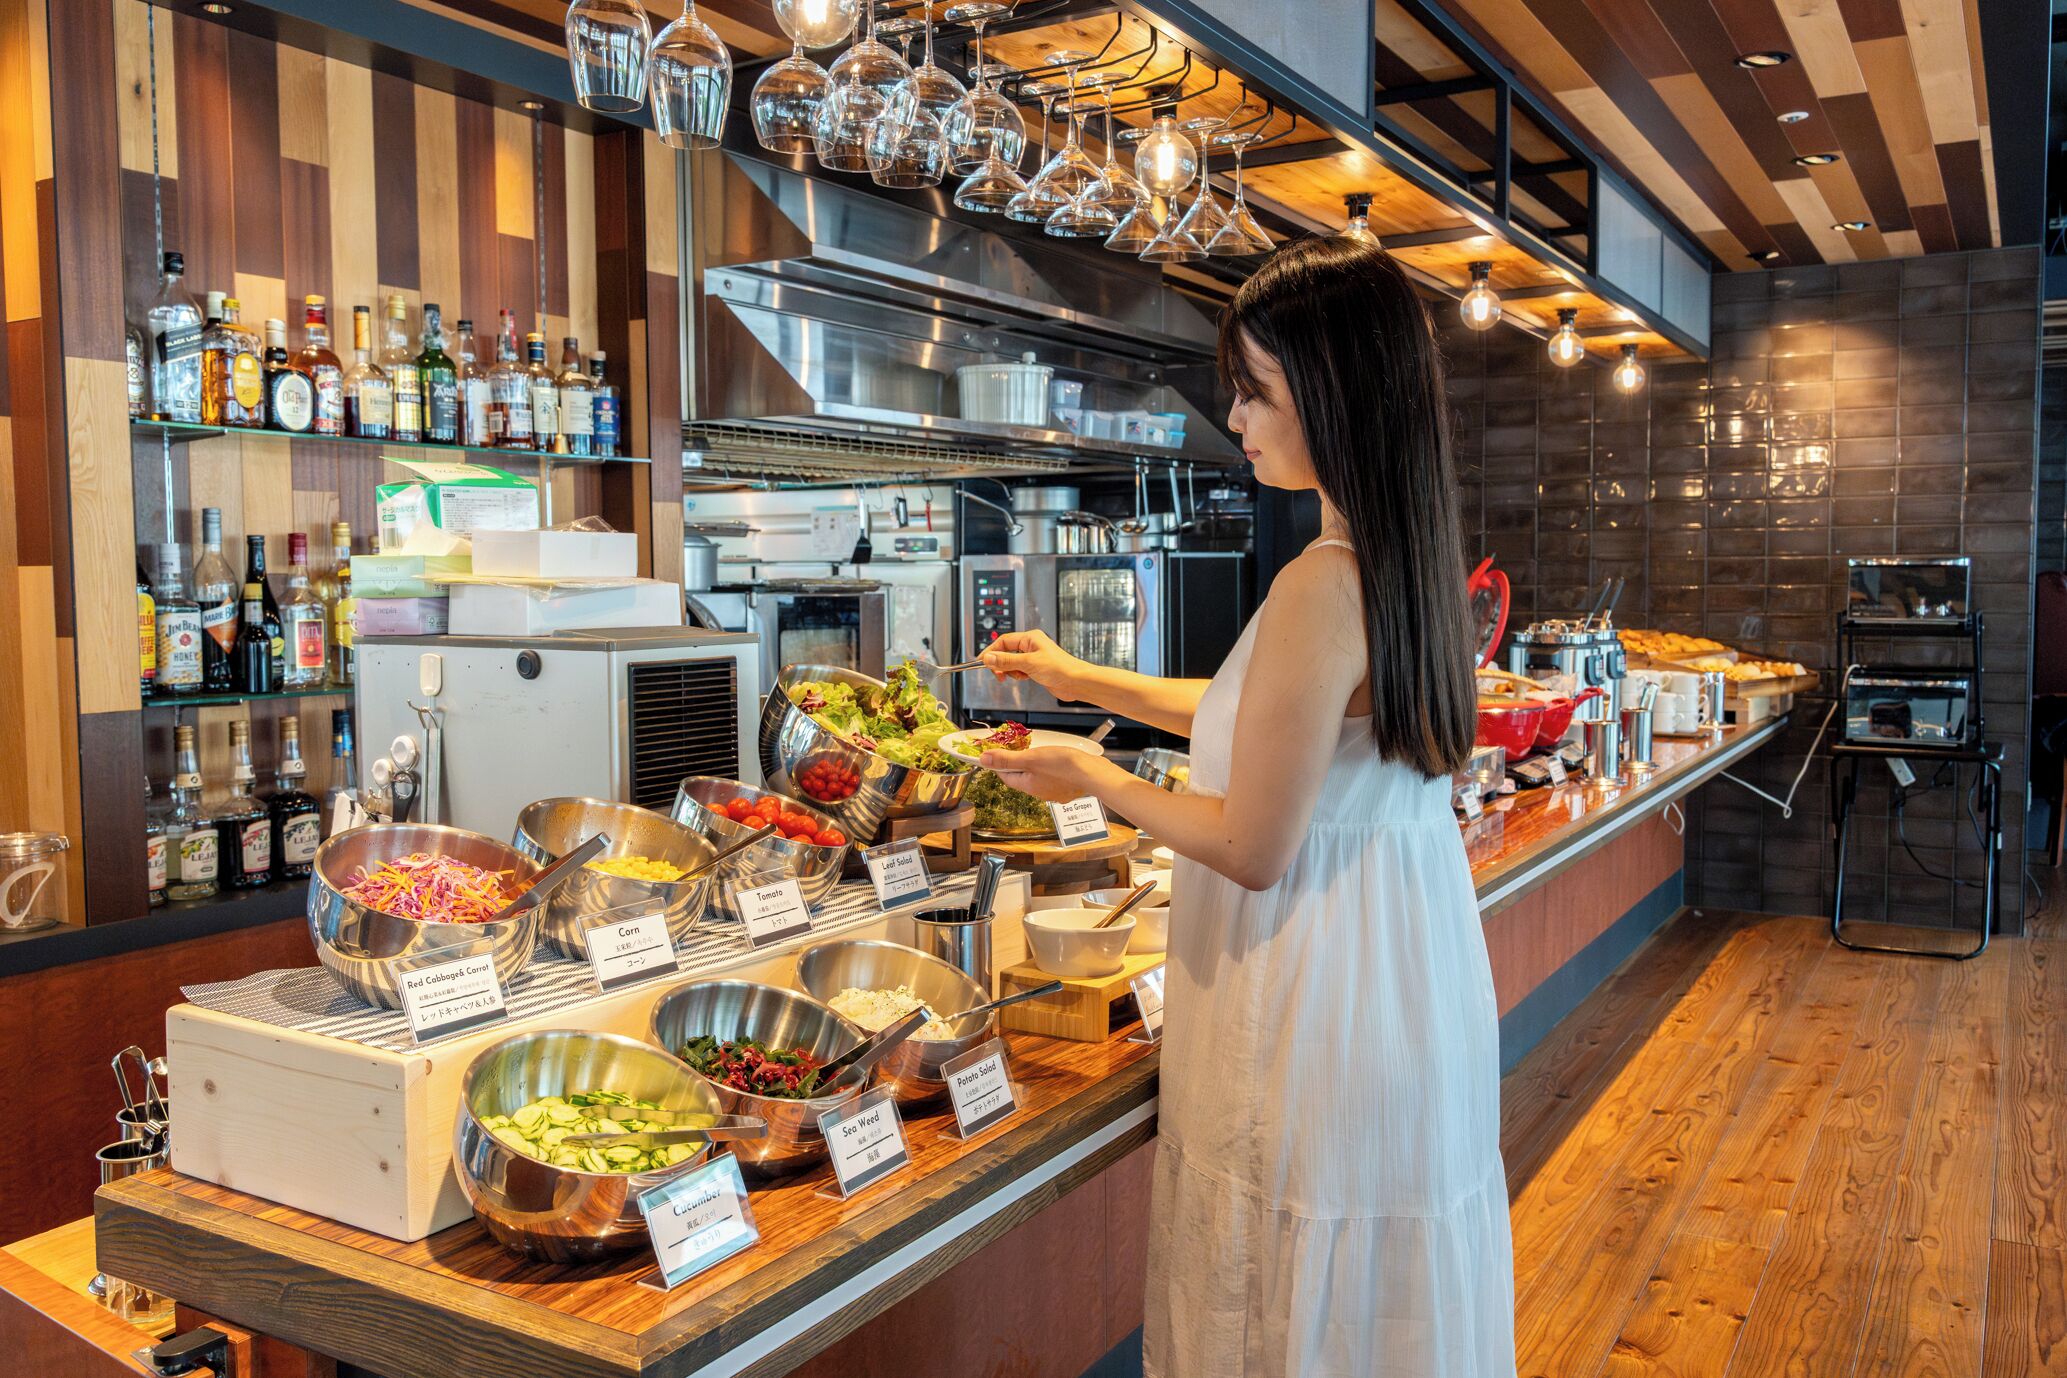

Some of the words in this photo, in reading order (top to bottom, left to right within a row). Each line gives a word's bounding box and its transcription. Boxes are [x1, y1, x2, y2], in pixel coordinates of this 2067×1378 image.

[204, 612, 224, 622] MARIE
[166, 624, 182, 637] JIM
[174, 652, 198, 662] HONEY
[1074, 802, 1092, 812] Grapes
[882, 858, 896, 870] Leaf
[896, 854, 913, 866] Salad
[756, 890, 783, 902] Tomato
[772, 916, 788, 928] トマト
[618, 926, 640, 937] Corn
[626, 957, 646, 968] コーン
[408, 978, 424, 990] Red
[426, 968, 465, 984] Cabbage&
[466, 964, 489, 976] Carrot
[957, 1072, 979, 1088] Potato
[979, 1060, 997, 1076] Salad
[842, 1126, 857, 1138] Sea
[858, 1110, 880, 1128] Weed
[673, 1188, 722, 1217] Cucumber
